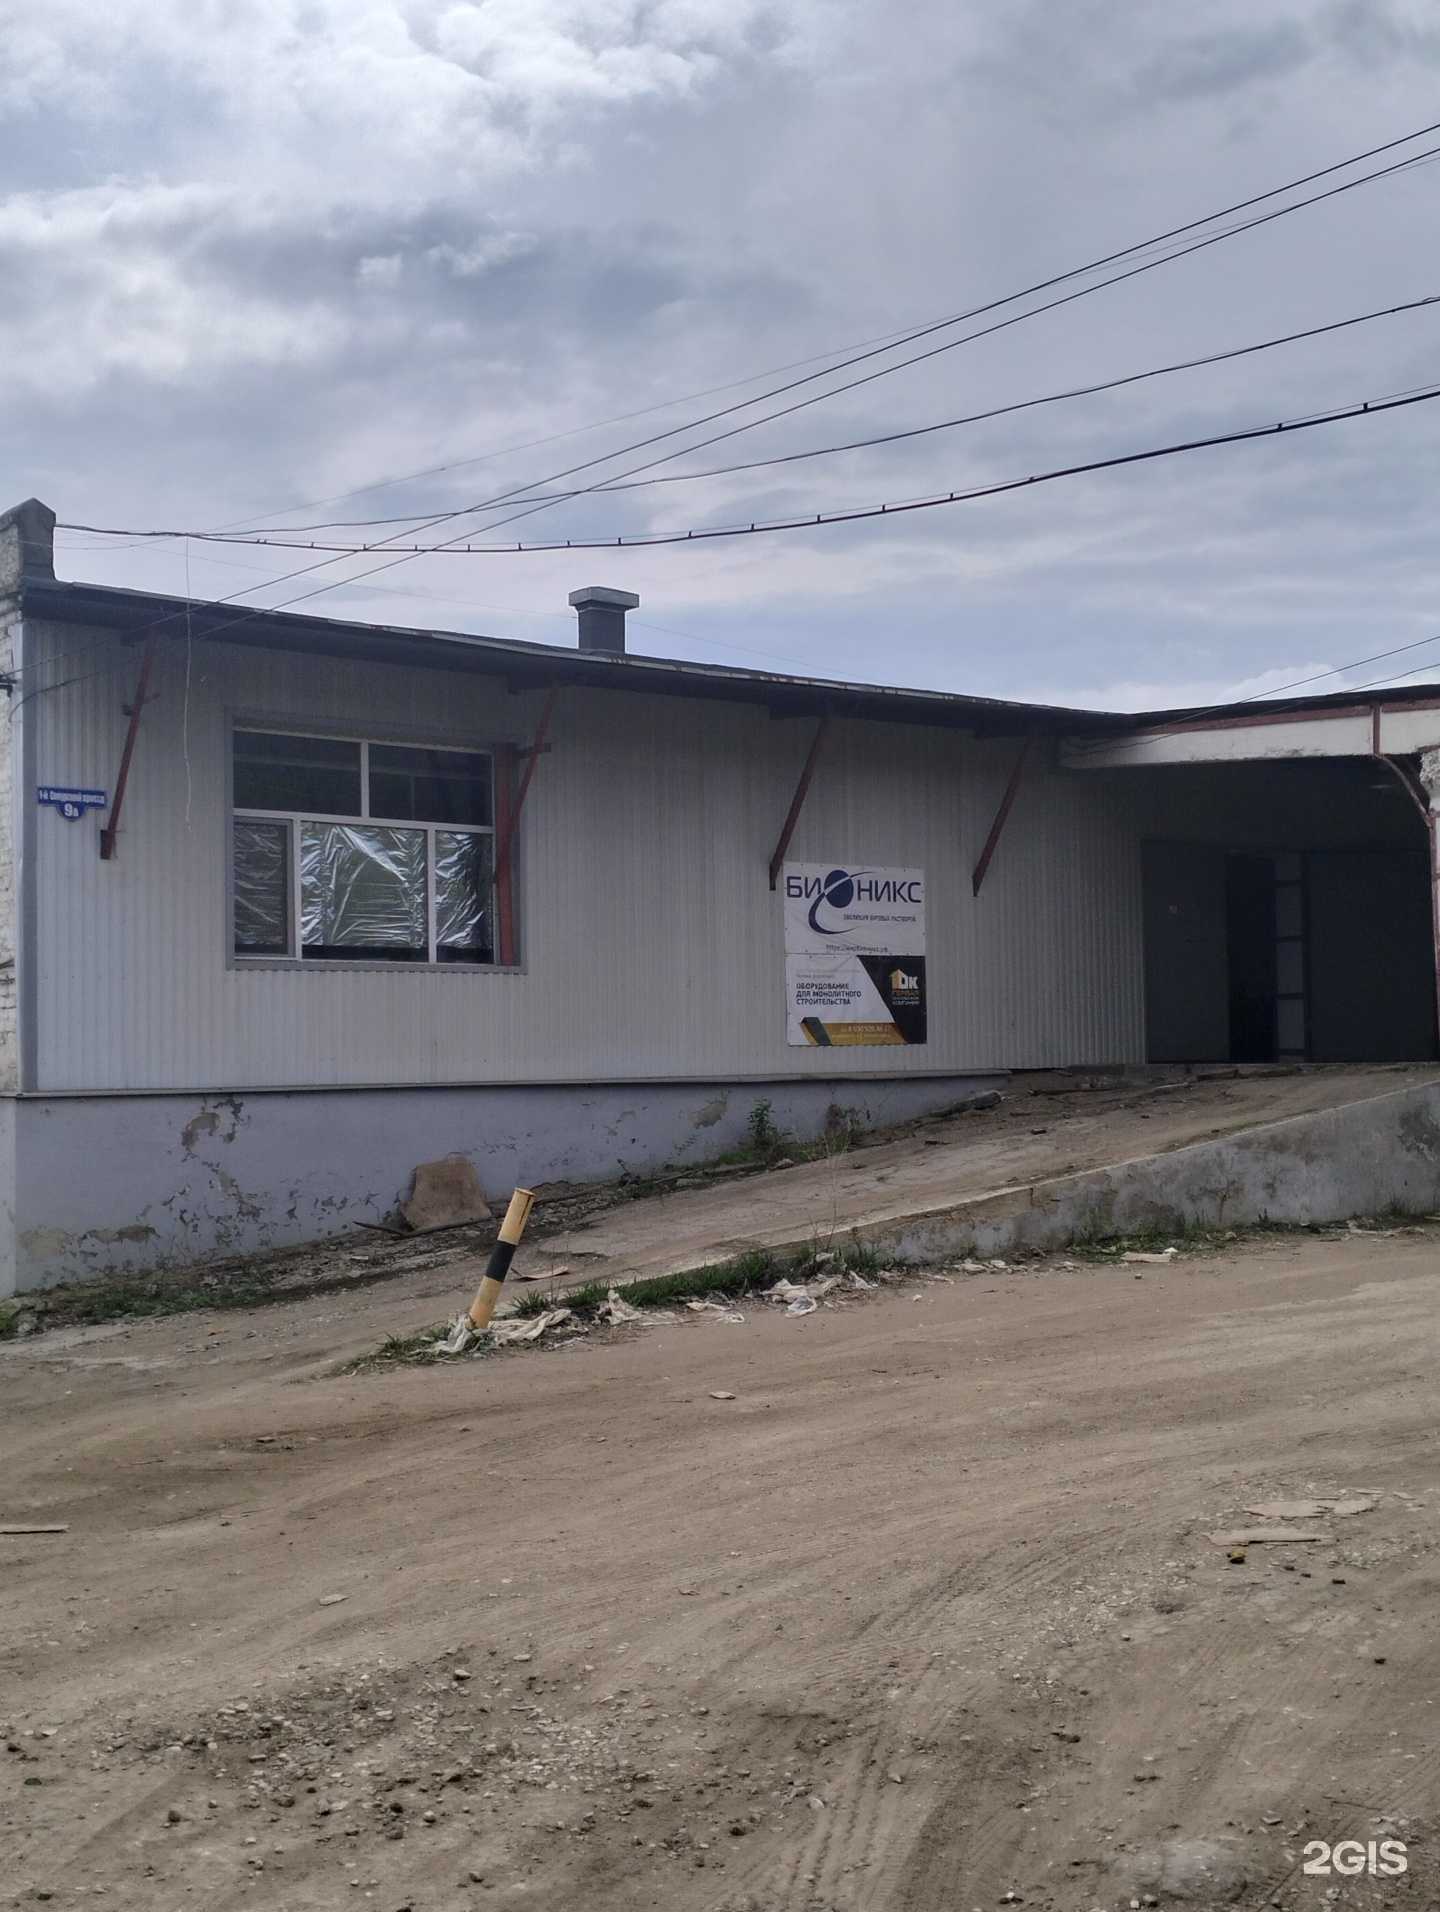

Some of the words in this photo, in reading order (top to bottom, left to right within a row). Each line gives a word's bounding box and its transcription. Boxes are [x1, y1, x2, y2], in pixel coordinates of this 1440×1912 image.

[786, 870, 922, 908] БИОНИКС
[796, 990, 811, 998] ДЛЯ
[812, 990, 862, 998] МОНОЛИТНОГО
[796, 998, 851, 1006] СТРОИТЕЛЬСТВА
